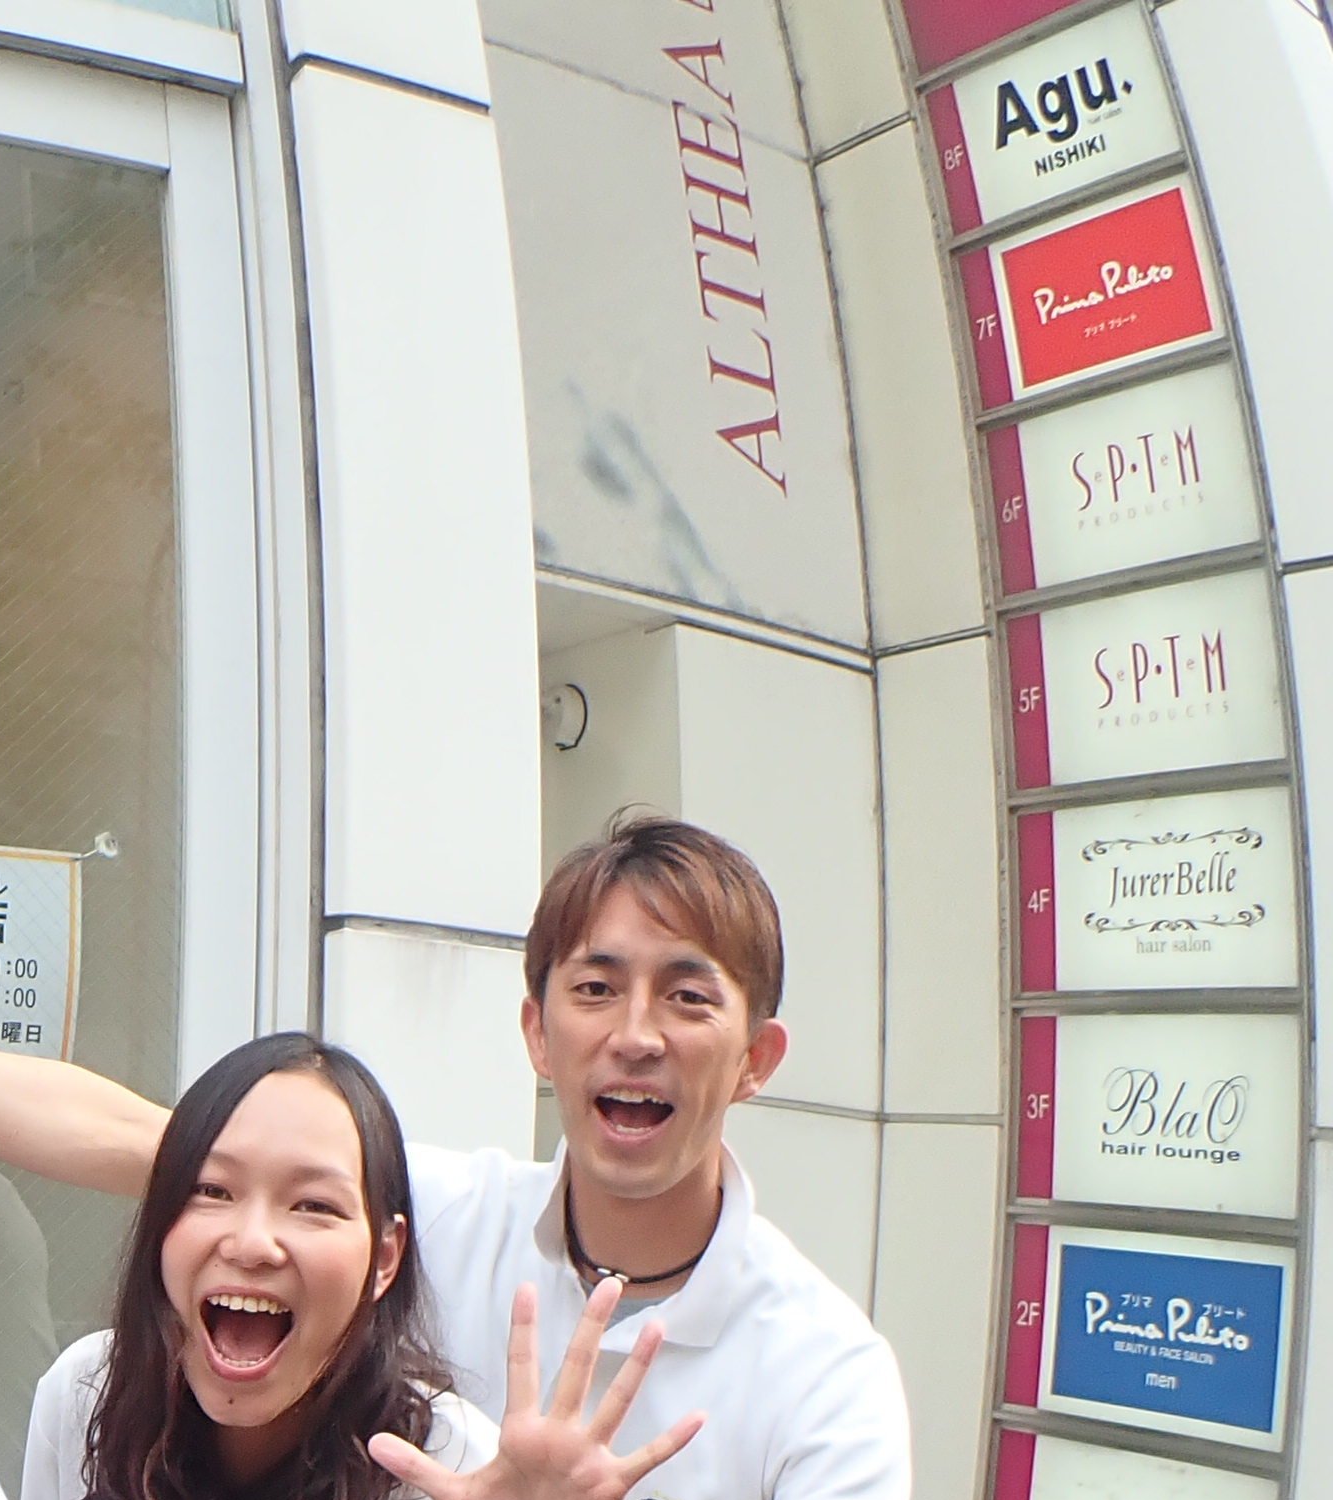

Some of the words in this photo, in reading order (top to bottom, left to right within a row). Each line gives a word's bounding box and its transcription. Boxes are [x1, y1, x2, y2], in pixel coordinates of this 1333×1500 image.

[995, 57, 1134, 151] Agu.
[943, 144, 964, 170] 8F
[1034, 134, 1107, 177] NISHIKI
[661, 38, 787, 498] ALTHEA
[976, 313, 998, 341] 7F
[1001, 496, 1024, 524] 6F
[1018, 686, 1041, 714] 5F
[1027, 888, 1051, 914] 4F
[1135, 935, 1168, 954] hair
[1172, 933, 1212, 953] salon
[1025, 1094, 1051, 1120] 3F
[1101, 1140, 1147, 1156] hair
[1155, 1143, 1241, 1165] lounge
[1015, 1300, 1041, 1327] 2F
[1113, 1340, 1149, 1356] BEAUTY
[1158, 1346, 1183, 1361] FACE
[1183, 1350, 1215, 1365] SALON
[1145, 1372, 1179, 1390] men
